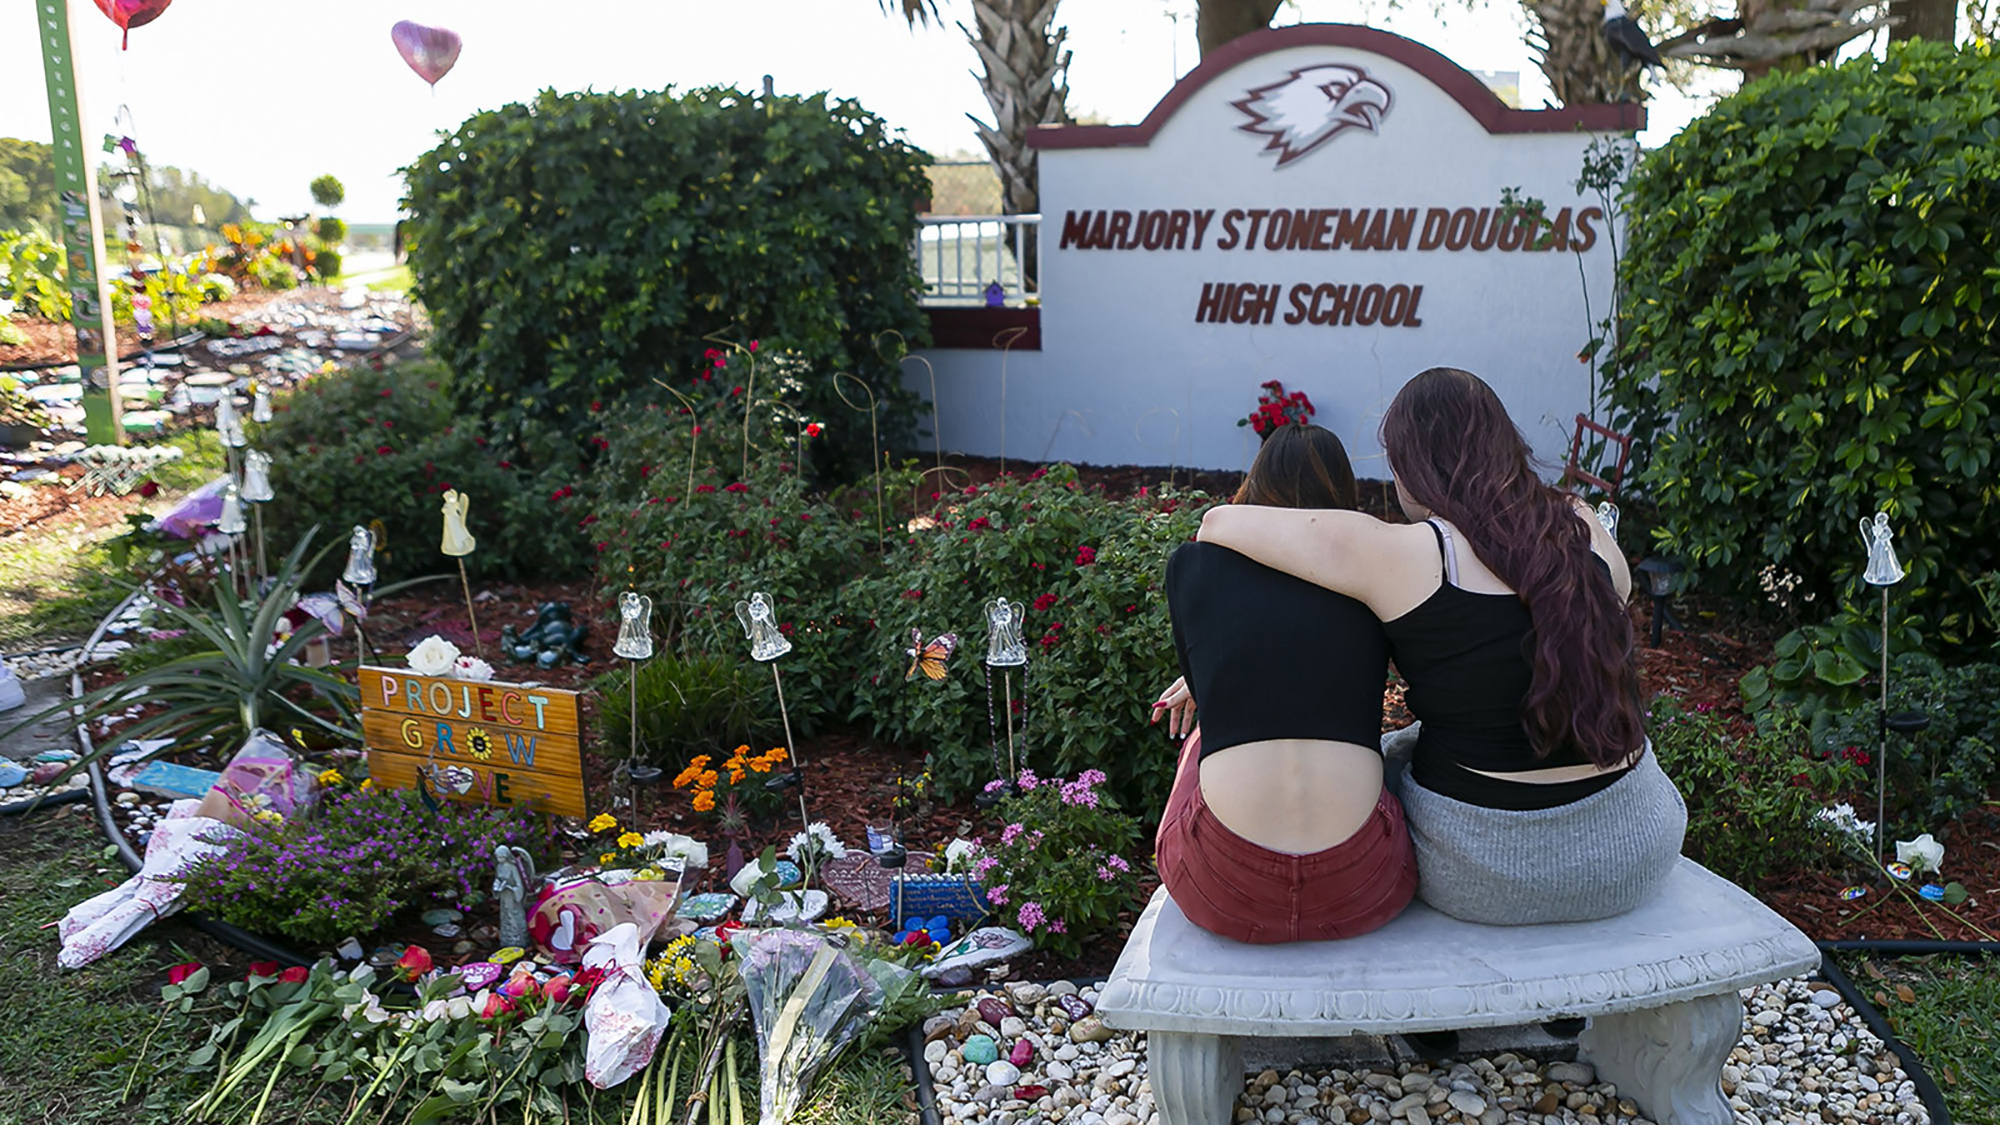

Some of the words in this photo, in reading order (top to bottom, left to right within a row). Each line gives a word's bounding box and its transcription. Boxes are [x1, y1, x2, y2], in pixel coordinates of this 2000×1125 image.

[1059, 209, 1215, 250] MARJORY
[1217, 208, 1418, 251] STONEMAN
[1417, 207, 1603, 252] DOUGLAS
[1195, 282, 1281, 325] HIGH
[1284, 283, 1423, 328] SCHOOL
[381, 675, 549, 731] PROJECT
